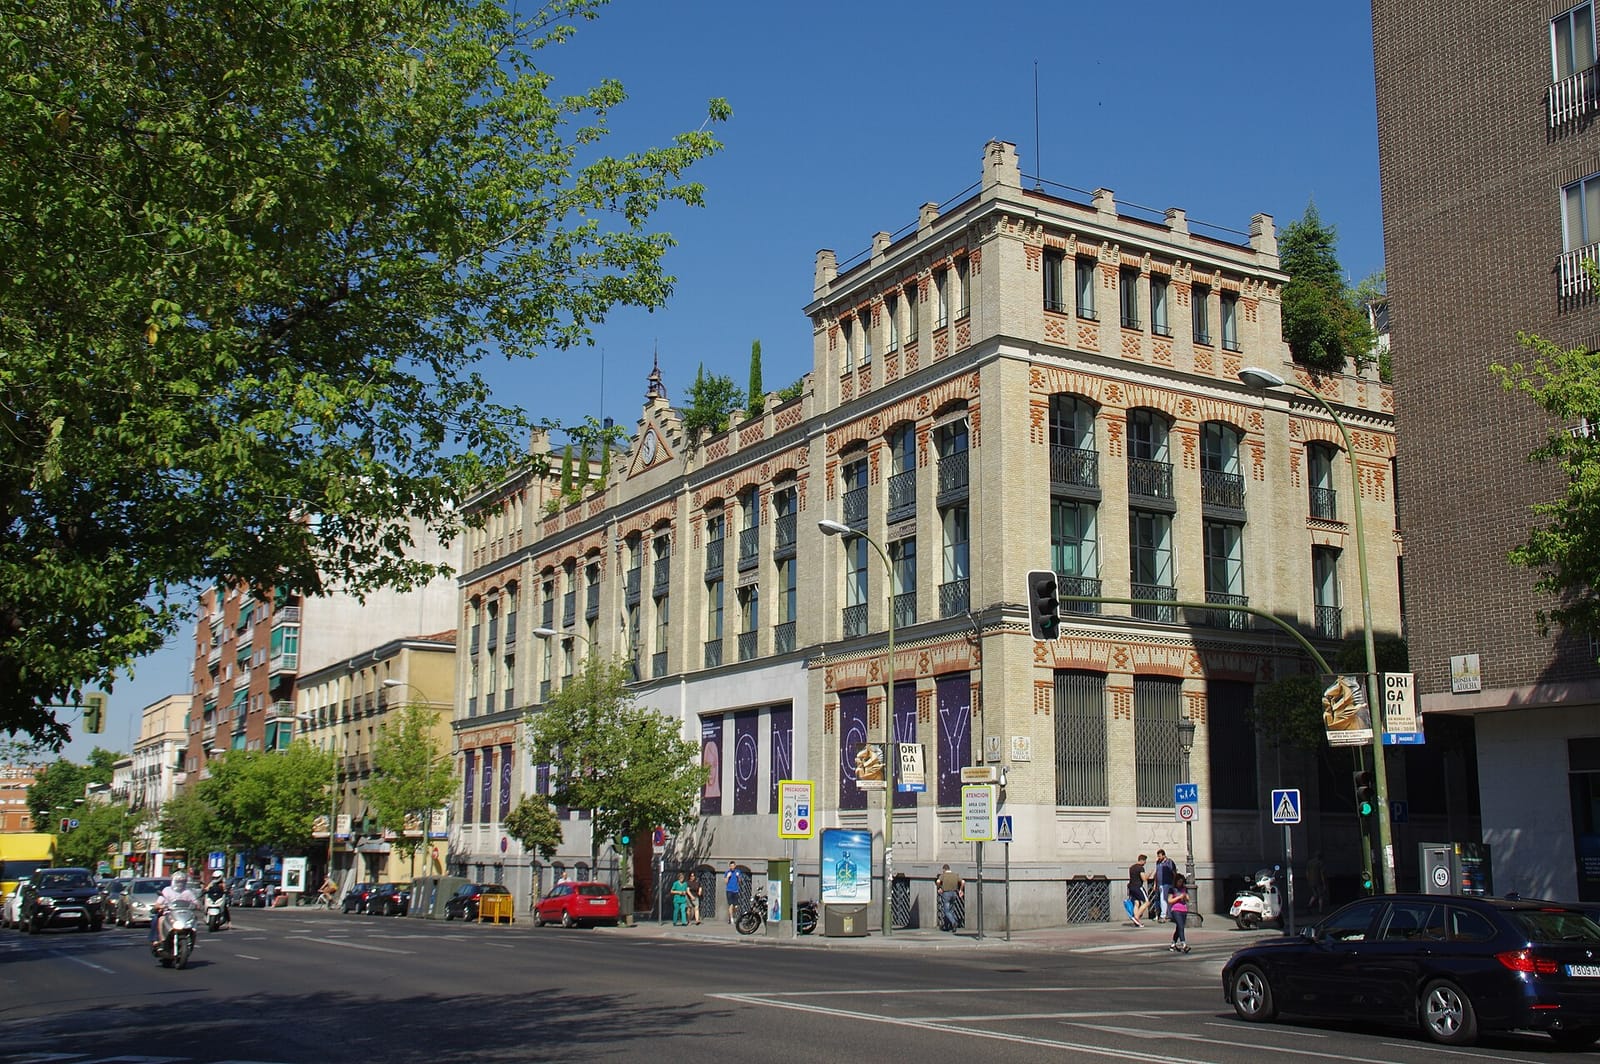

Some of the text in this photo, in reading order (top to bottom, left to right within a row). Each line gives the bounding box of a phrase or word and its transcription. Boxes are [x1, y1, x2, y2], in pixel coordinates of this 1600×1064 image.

[1386, 676, 1408, 688] ORI
[1387, 690, 1404, 701] GA
[1388, 704, 1402, 715] MI
[901, 745, 917, 754] ORI
[1394, 803, 1402, 820] P
